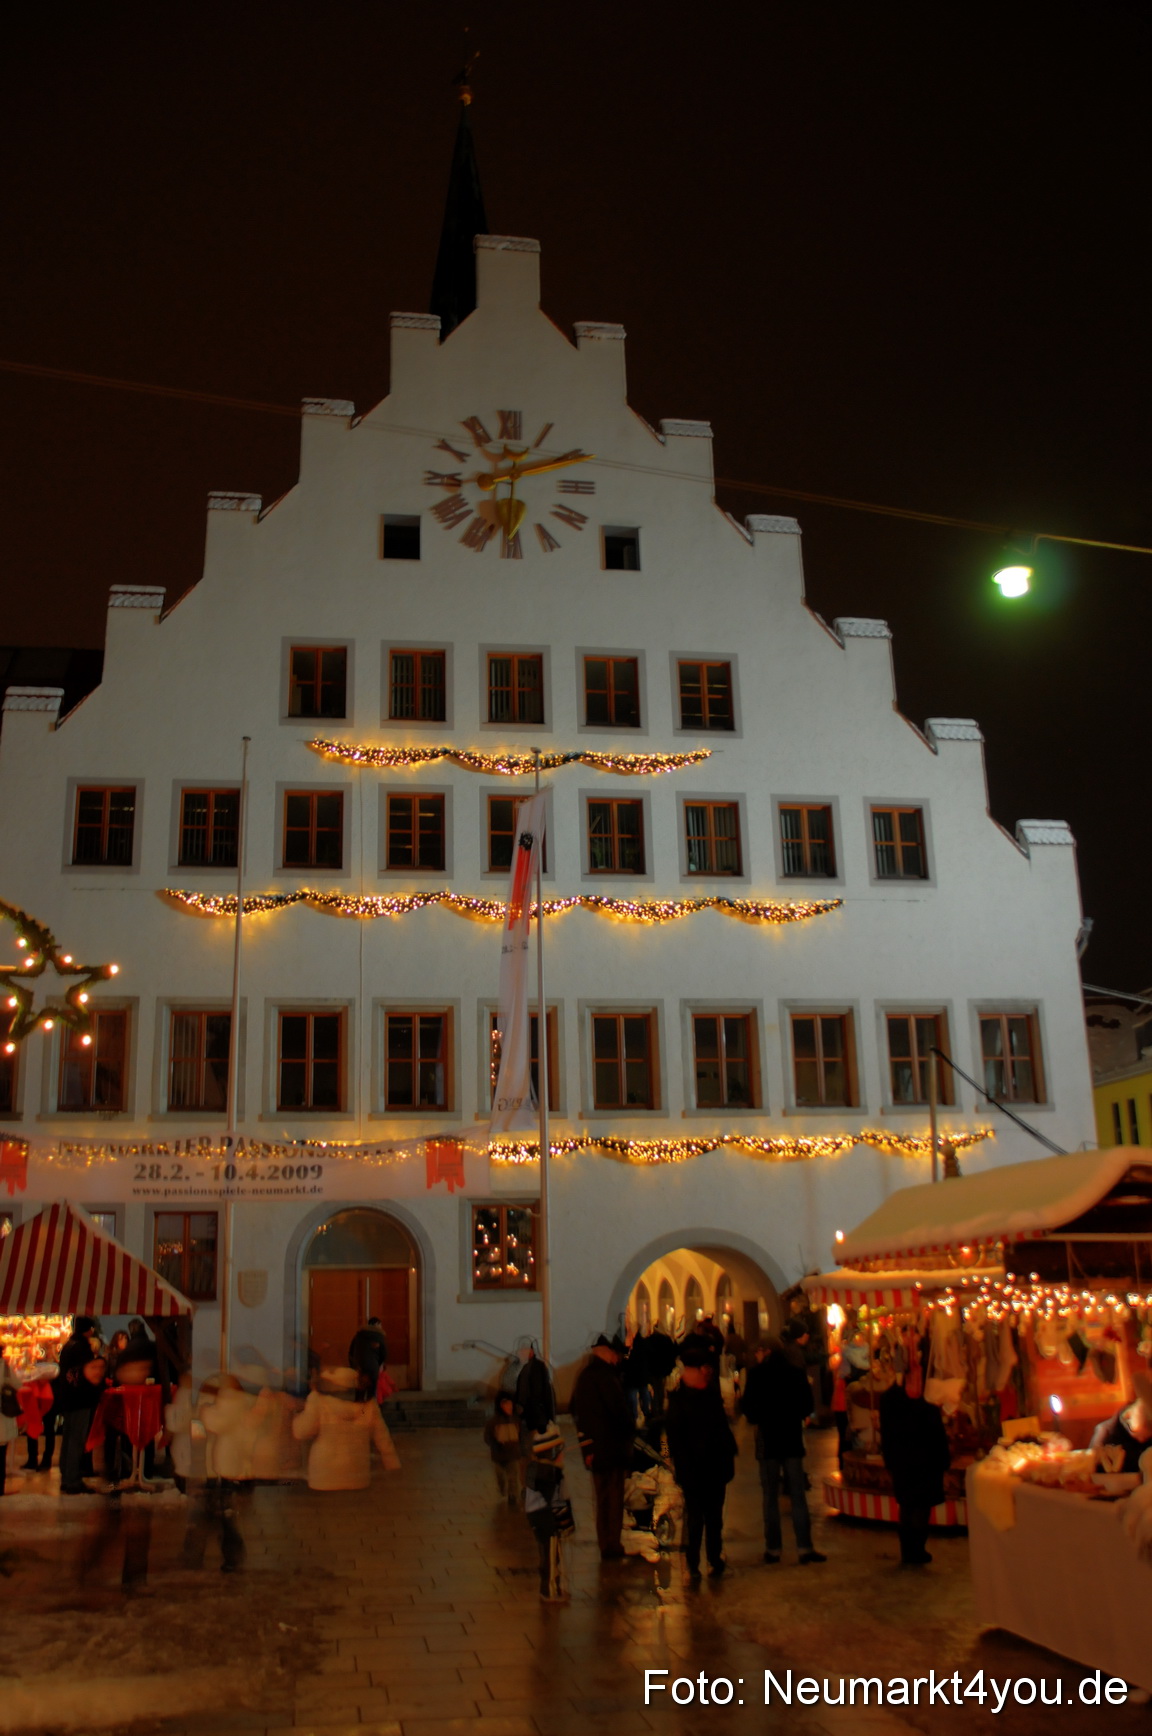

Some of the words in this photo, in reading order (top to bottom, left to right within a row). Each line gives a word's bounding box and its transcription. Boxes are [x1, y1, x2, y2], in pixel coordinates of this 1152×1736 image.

[496, 410, 522, 440] XII
[433, 438, 470, 463] X
[557, 480, 596, 494] III
[133, 1163, 190, 1181] 28.2.
[211, 1163, 324, 1181] 10.4.2009
[132, 1185, 324, 1197] www.passionsspiele-neumarkt.de
